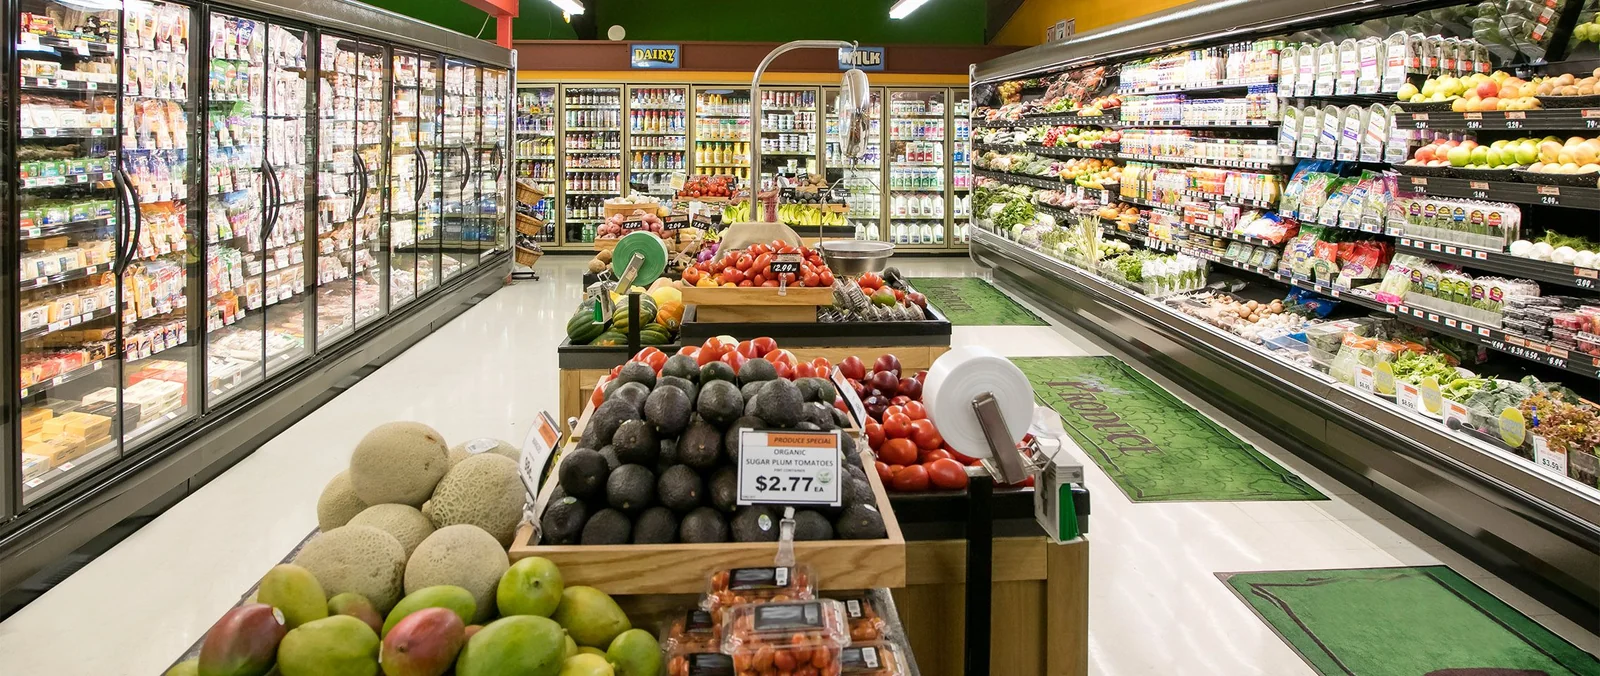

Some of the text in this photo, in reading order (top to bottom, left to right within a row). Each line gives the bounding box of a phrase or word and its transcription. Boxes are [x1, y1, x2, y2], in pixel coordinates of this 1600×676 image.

[634, 48, 676, 62] DAIRY
[841, 50, 881, 65] MILK
[806, 437, 831, 445] SPECIAL
[774, 448, 806, 456] ORGANIC
[755, 474, 814, 493] $2.77
